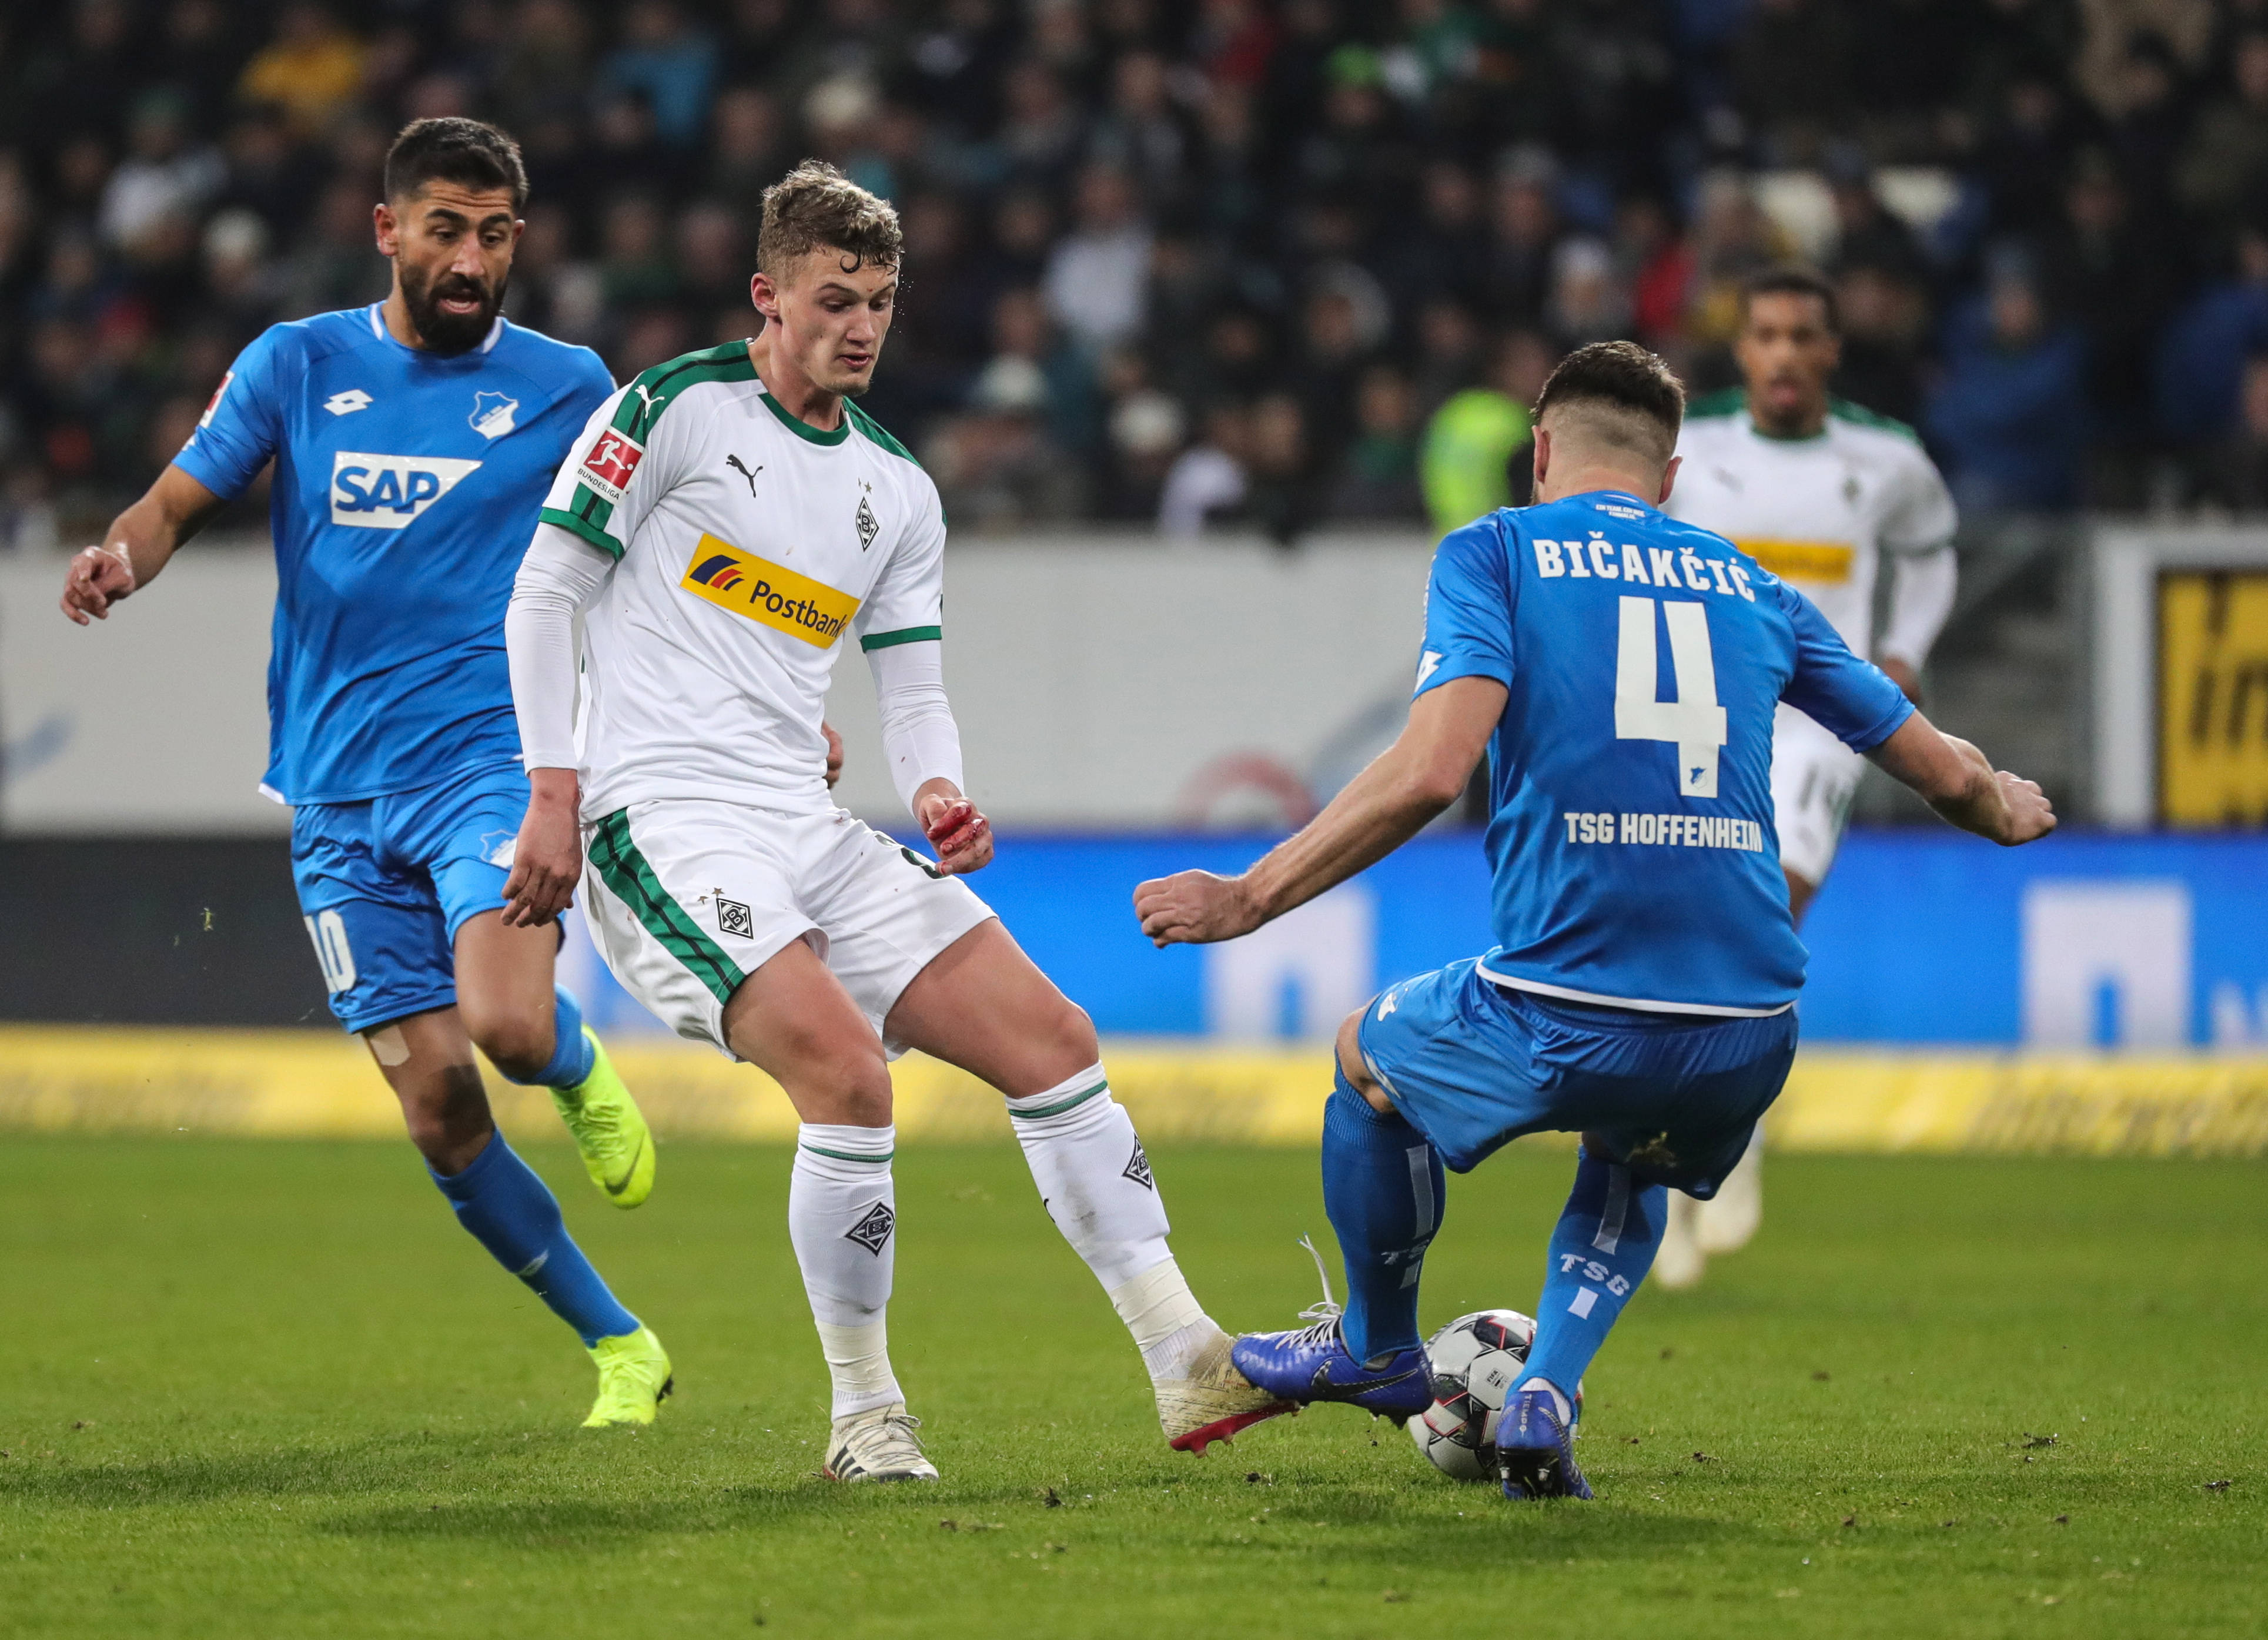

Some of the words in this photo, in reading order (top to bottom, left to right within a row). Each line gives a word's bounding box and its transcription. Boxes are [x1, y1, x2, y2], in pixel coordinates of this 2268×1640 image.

[335, 466, 440, 514] SAP
[577, 468, 620, 500] BUNDESLIGA
[749, 579, 848, 638] Postbank
[1614, 595, 1728, 799] 4
[1564, 812, 1614, 844] TSG
[1620, 813, 1763, 853] HOFFENHEIM
[1560, 1253, 1630, 1297] TSG
[1486, 1369, 1499, 1383] FIFA
